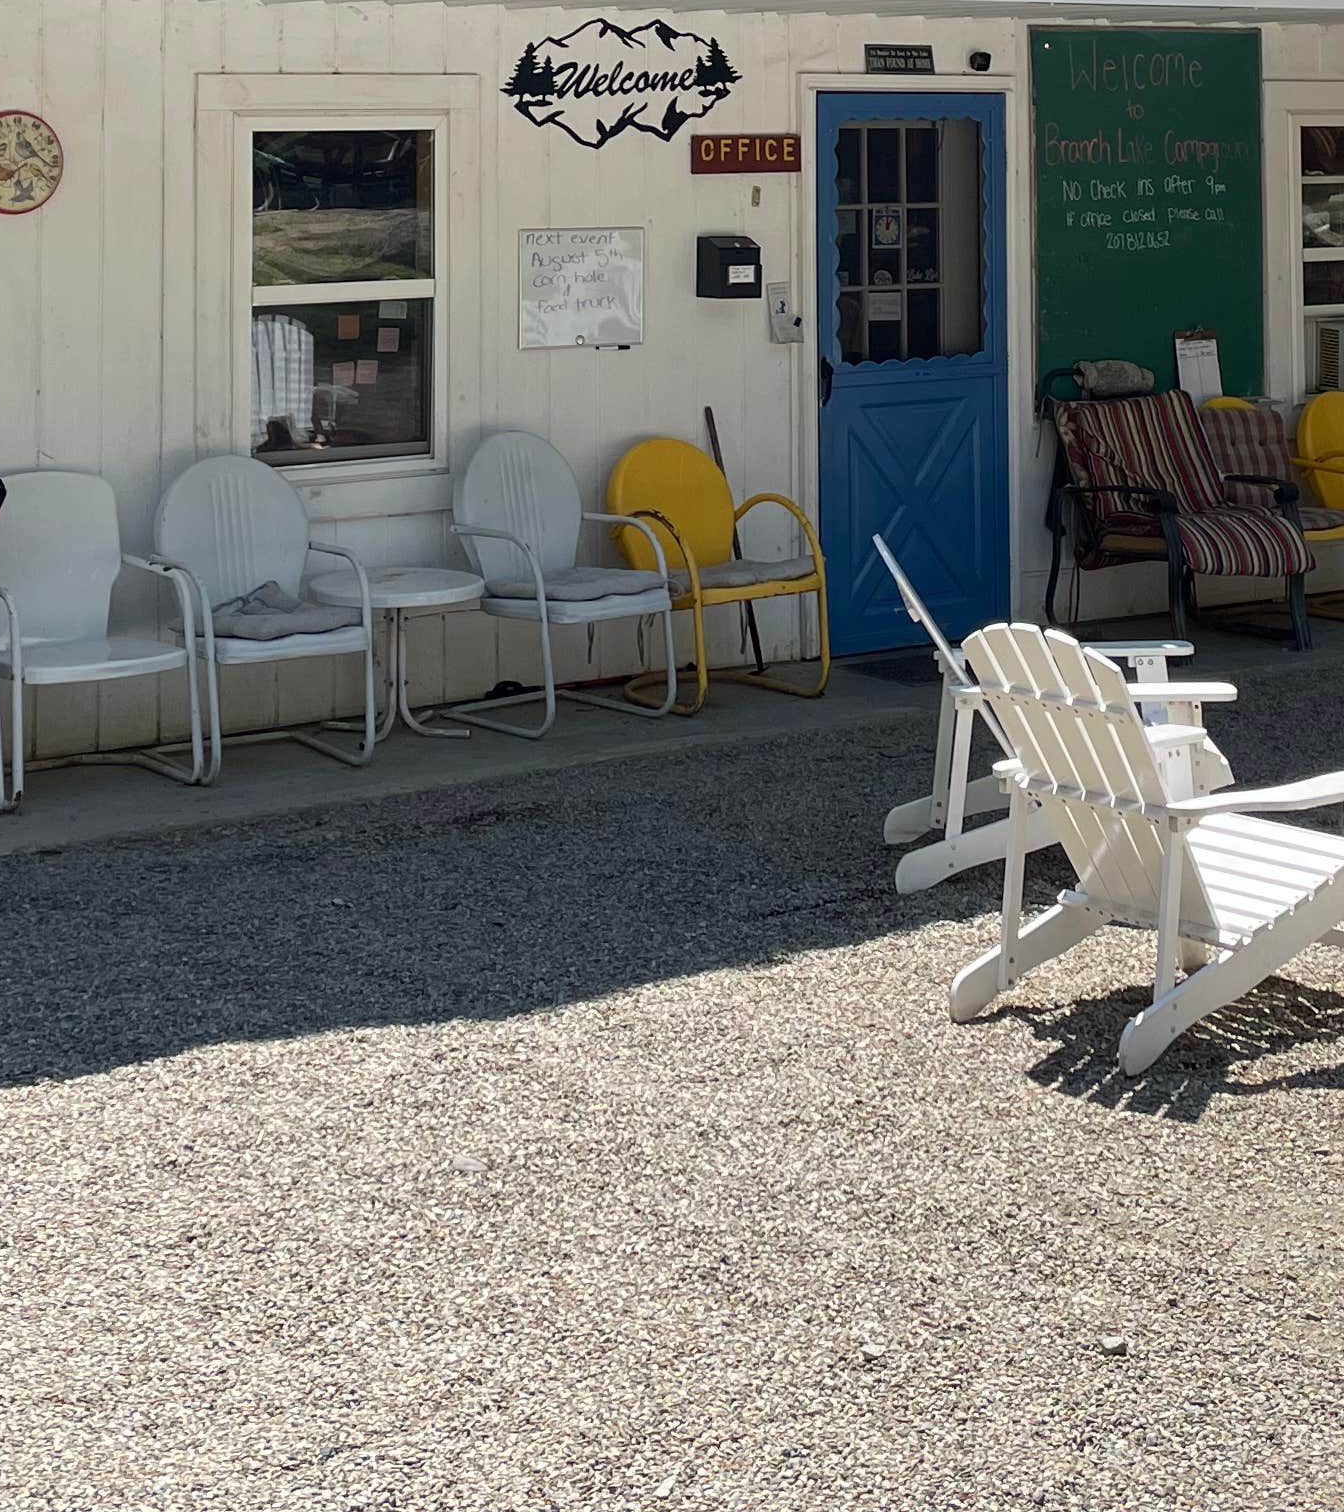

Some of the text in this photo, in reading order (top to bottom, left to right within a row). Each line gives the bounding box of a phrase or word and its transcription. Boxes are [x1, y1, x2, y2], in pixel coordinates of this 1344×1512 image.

[1068, 39, 1203, 92] Welcome
[554, 60, 698, 101] Welcome
[1126, 99, 1145, 120] to
[700, 138, 795, 162] OFFICE
[1044, 122, 1112, 167] Branch
[526, 231, 616, 246] next event
[531, 248, 625, 272] August 5th
[574, 269, 605, 284] hole
